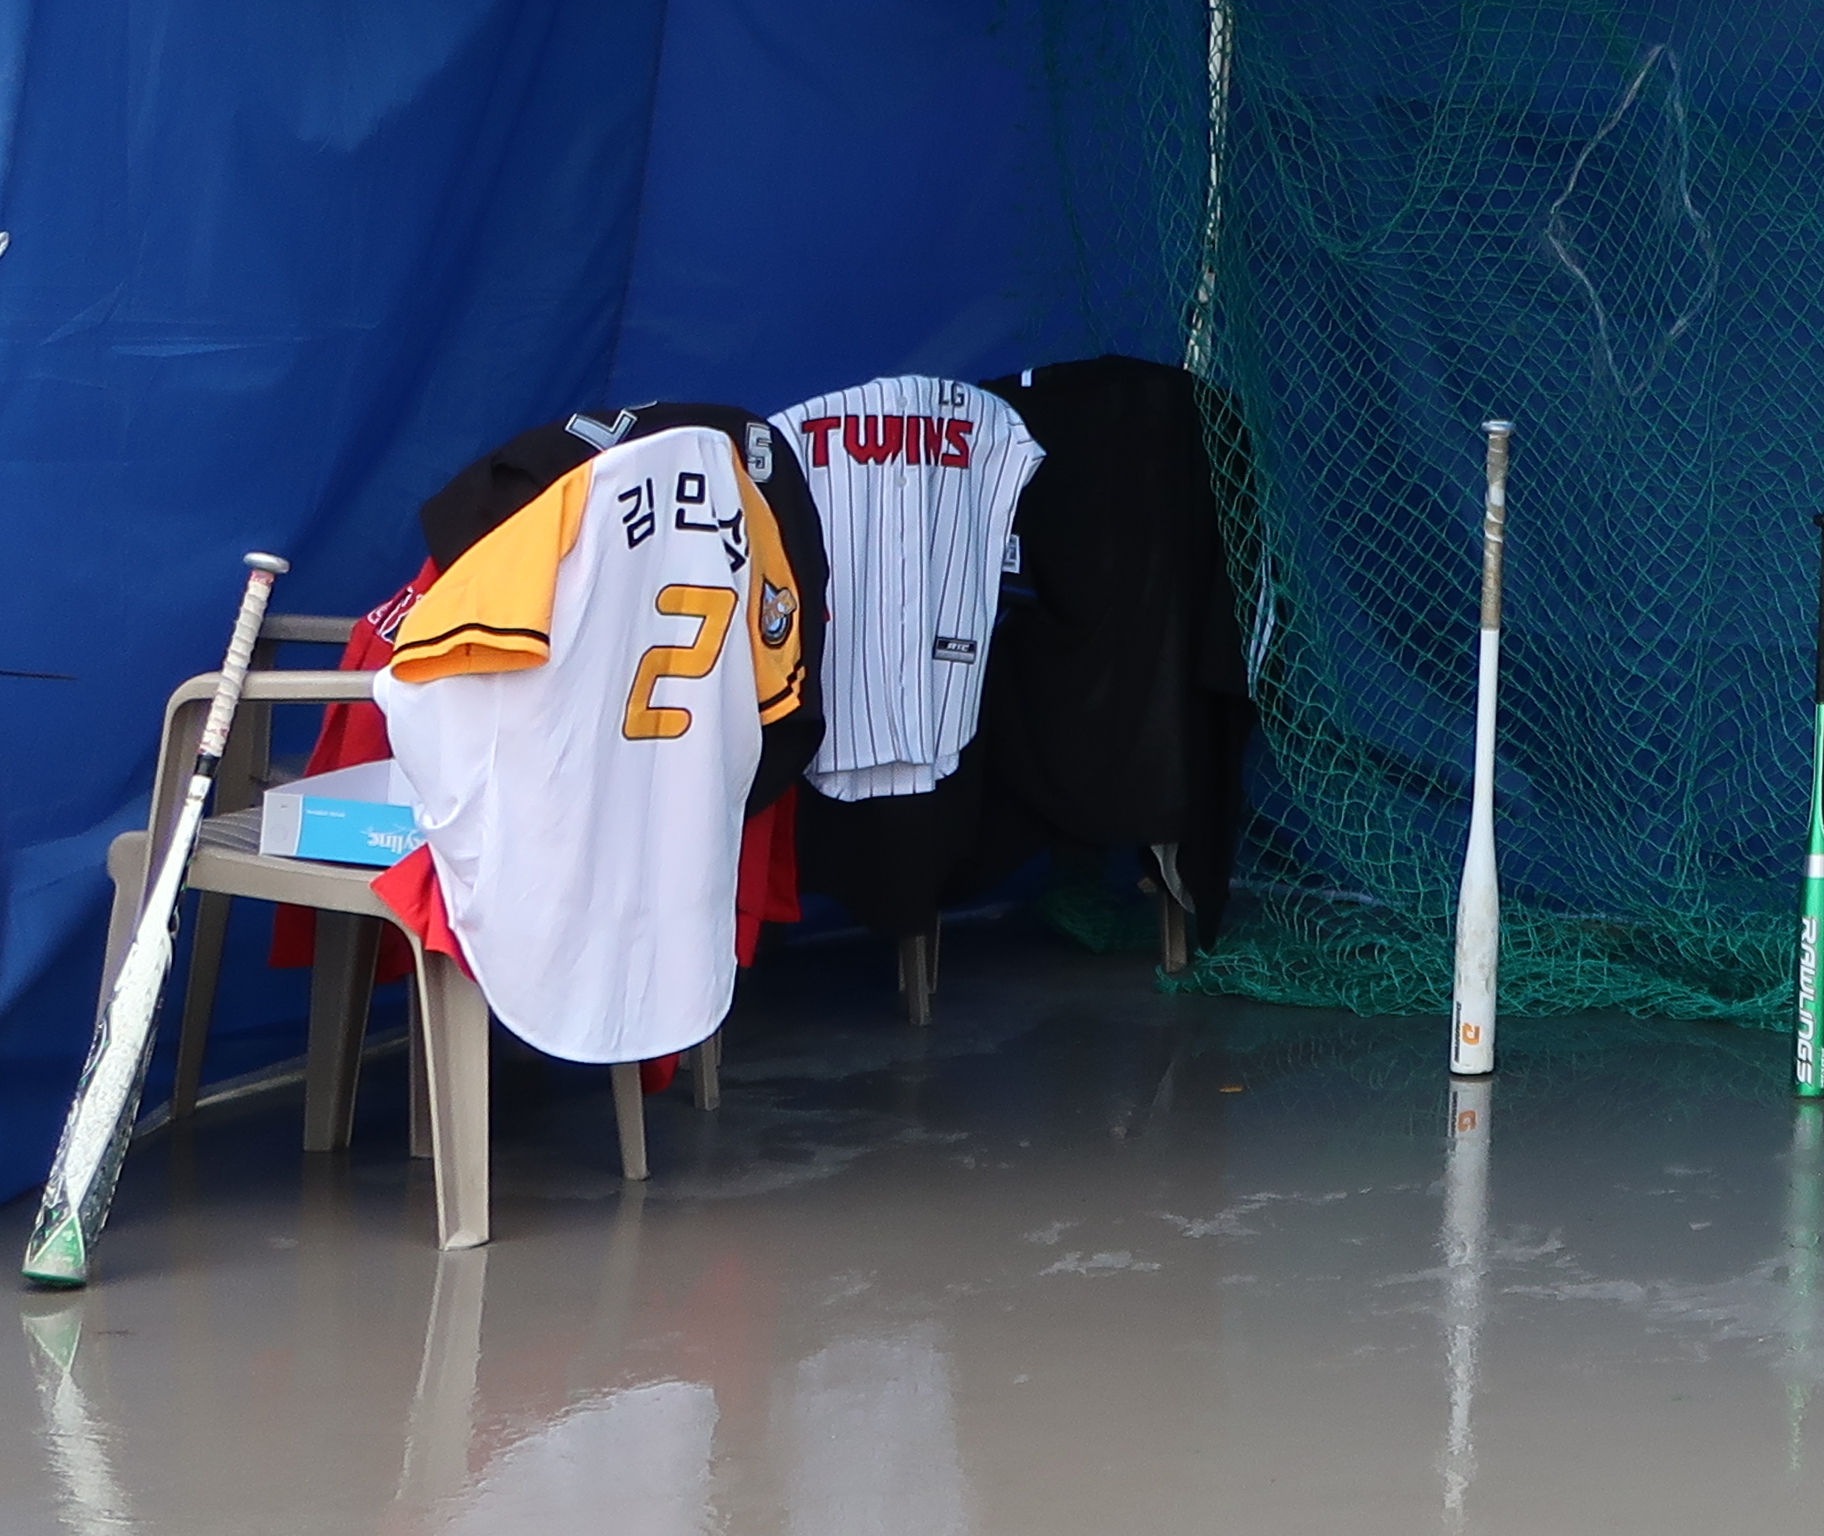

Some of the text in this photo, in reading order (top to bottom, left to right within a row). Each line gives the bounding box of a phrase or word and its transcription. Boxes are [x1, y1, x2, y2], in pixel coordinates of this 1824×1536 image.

[801, 414, 974, 470] TWINS
[938, 379, 965, 407] LG
[622, 583, 739, 741] 2
[1797, 917, 1820, 1085] RAWLINGS
